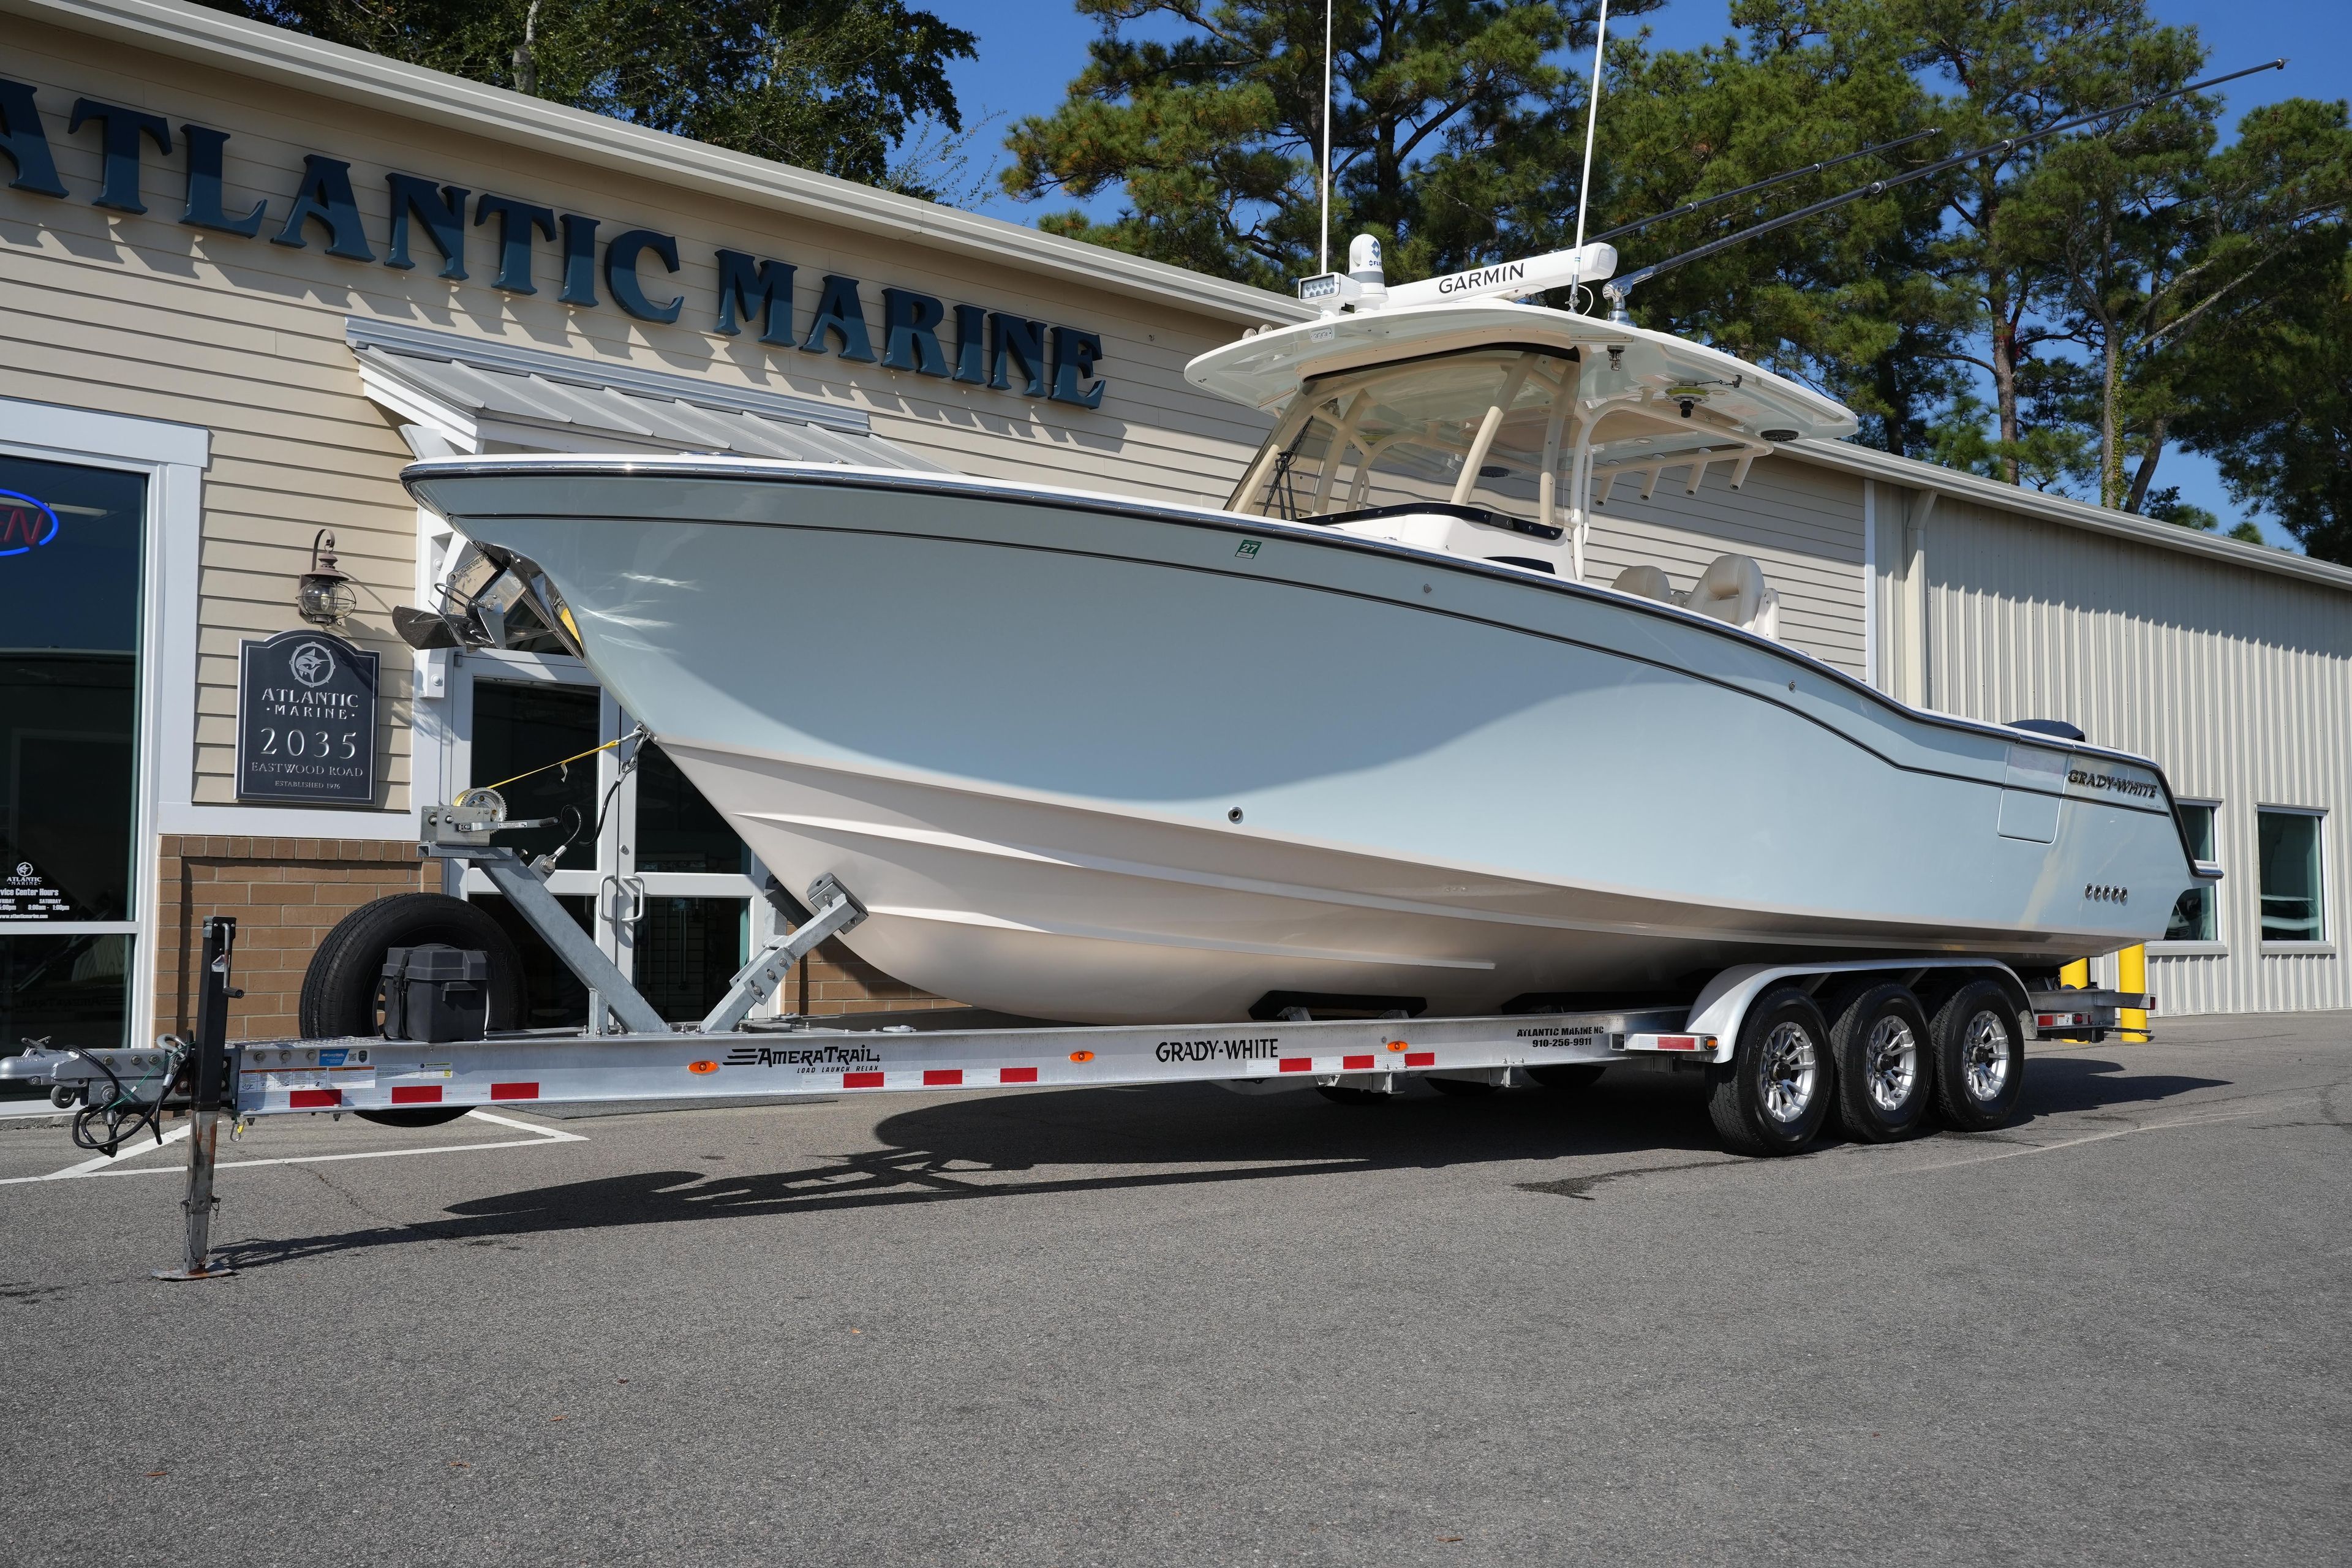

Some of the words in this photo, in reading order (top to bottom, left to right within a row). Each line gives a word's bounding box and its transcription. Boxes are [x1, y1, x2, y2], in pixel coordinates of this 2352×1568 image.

[0, 78, 684, 325] ATLANTIC
[714, 249, 1107, 410] MARINE
[1439, 263, 1524, 294] GARMIN
[1240, 543, 1259, 553] 27
[262, 688, 358, 707] ATLANTIC
[260, 727, 356, 759] 2035
[252, 762, 324, 774] EASTWOOD
[330, 766, 363, 777] ROAD
[275, 780, 324, 789] ESTABLISHED
[2068, 769, 2157, 798] GRADY-WHITE
[1517, 1028, 1559, 1037] ATLANTIC
[1156, 1038, 1278, 1063] GRADY-WHITE
[1532, 1038, 1592, 1047] 910-256-9911
